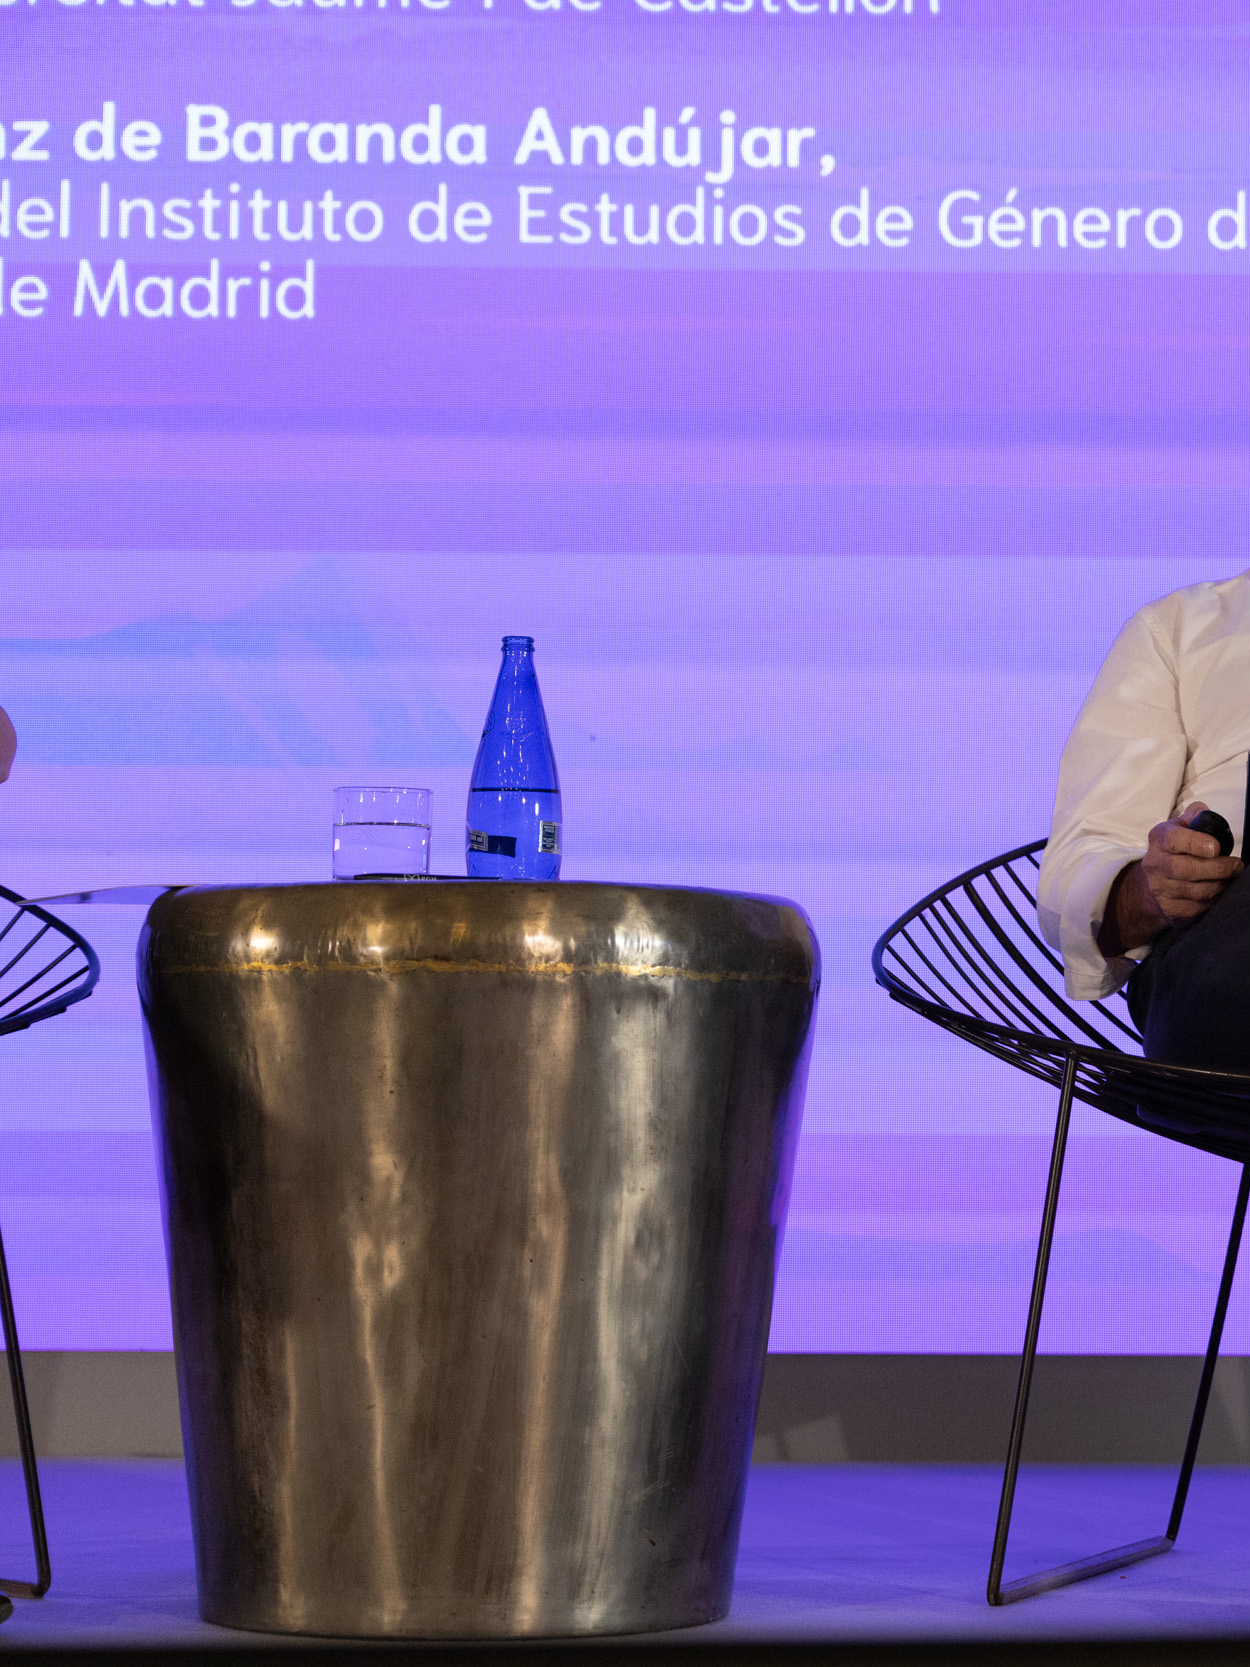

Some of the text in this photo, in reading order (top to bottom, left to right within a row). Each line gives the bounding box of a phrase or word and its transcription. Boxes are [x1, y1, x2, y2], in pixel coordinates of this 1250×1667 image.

[0, 101, 837, 185] z de Baranda Andújar,
[0, 178, 71, 240] el
[99, 180, 384, 244] Instituto
[408, 182, 493, 245] de
[517, 184, 806, 247] Estudios
[830, 186, 914, 249] de
[938, 188, 1183, 250] Género
[0, 256, 316, 321] e Madrid
